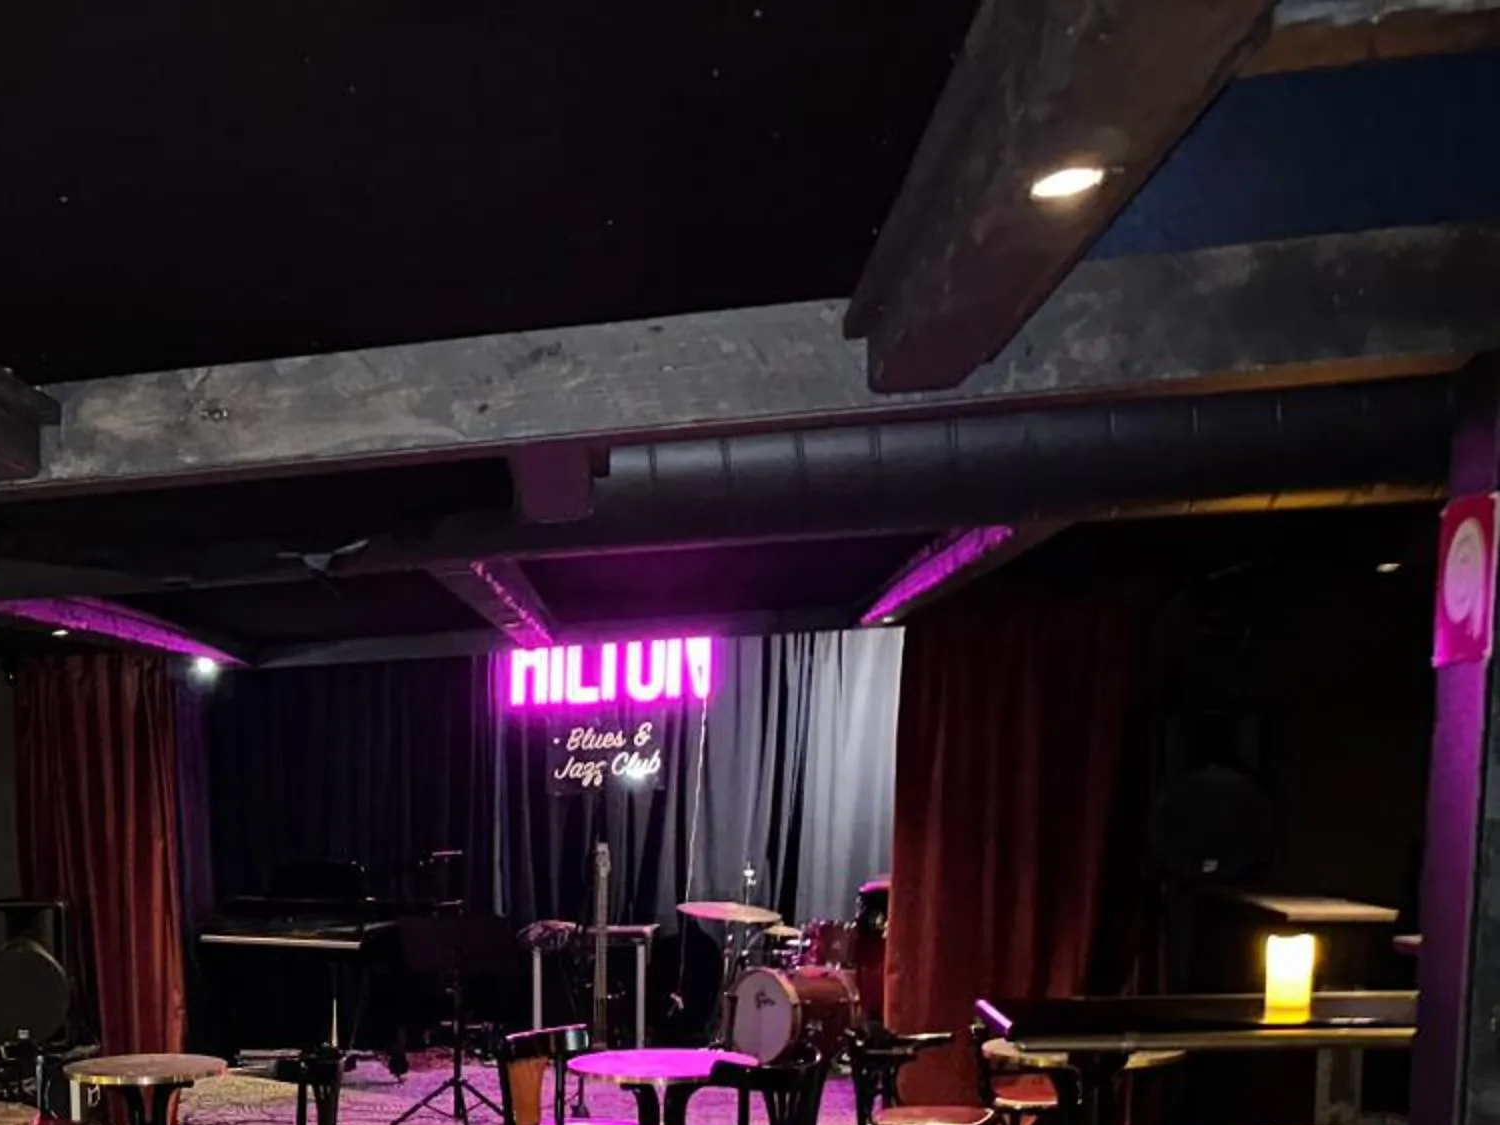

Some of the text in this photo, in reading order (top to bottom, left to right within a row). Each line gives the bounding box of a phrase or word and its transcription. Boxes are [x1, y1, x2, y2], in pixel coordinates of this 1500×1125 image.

[566, 722, 653, 751] Blues &
[554, 750, 661, 787] Jazz Club
